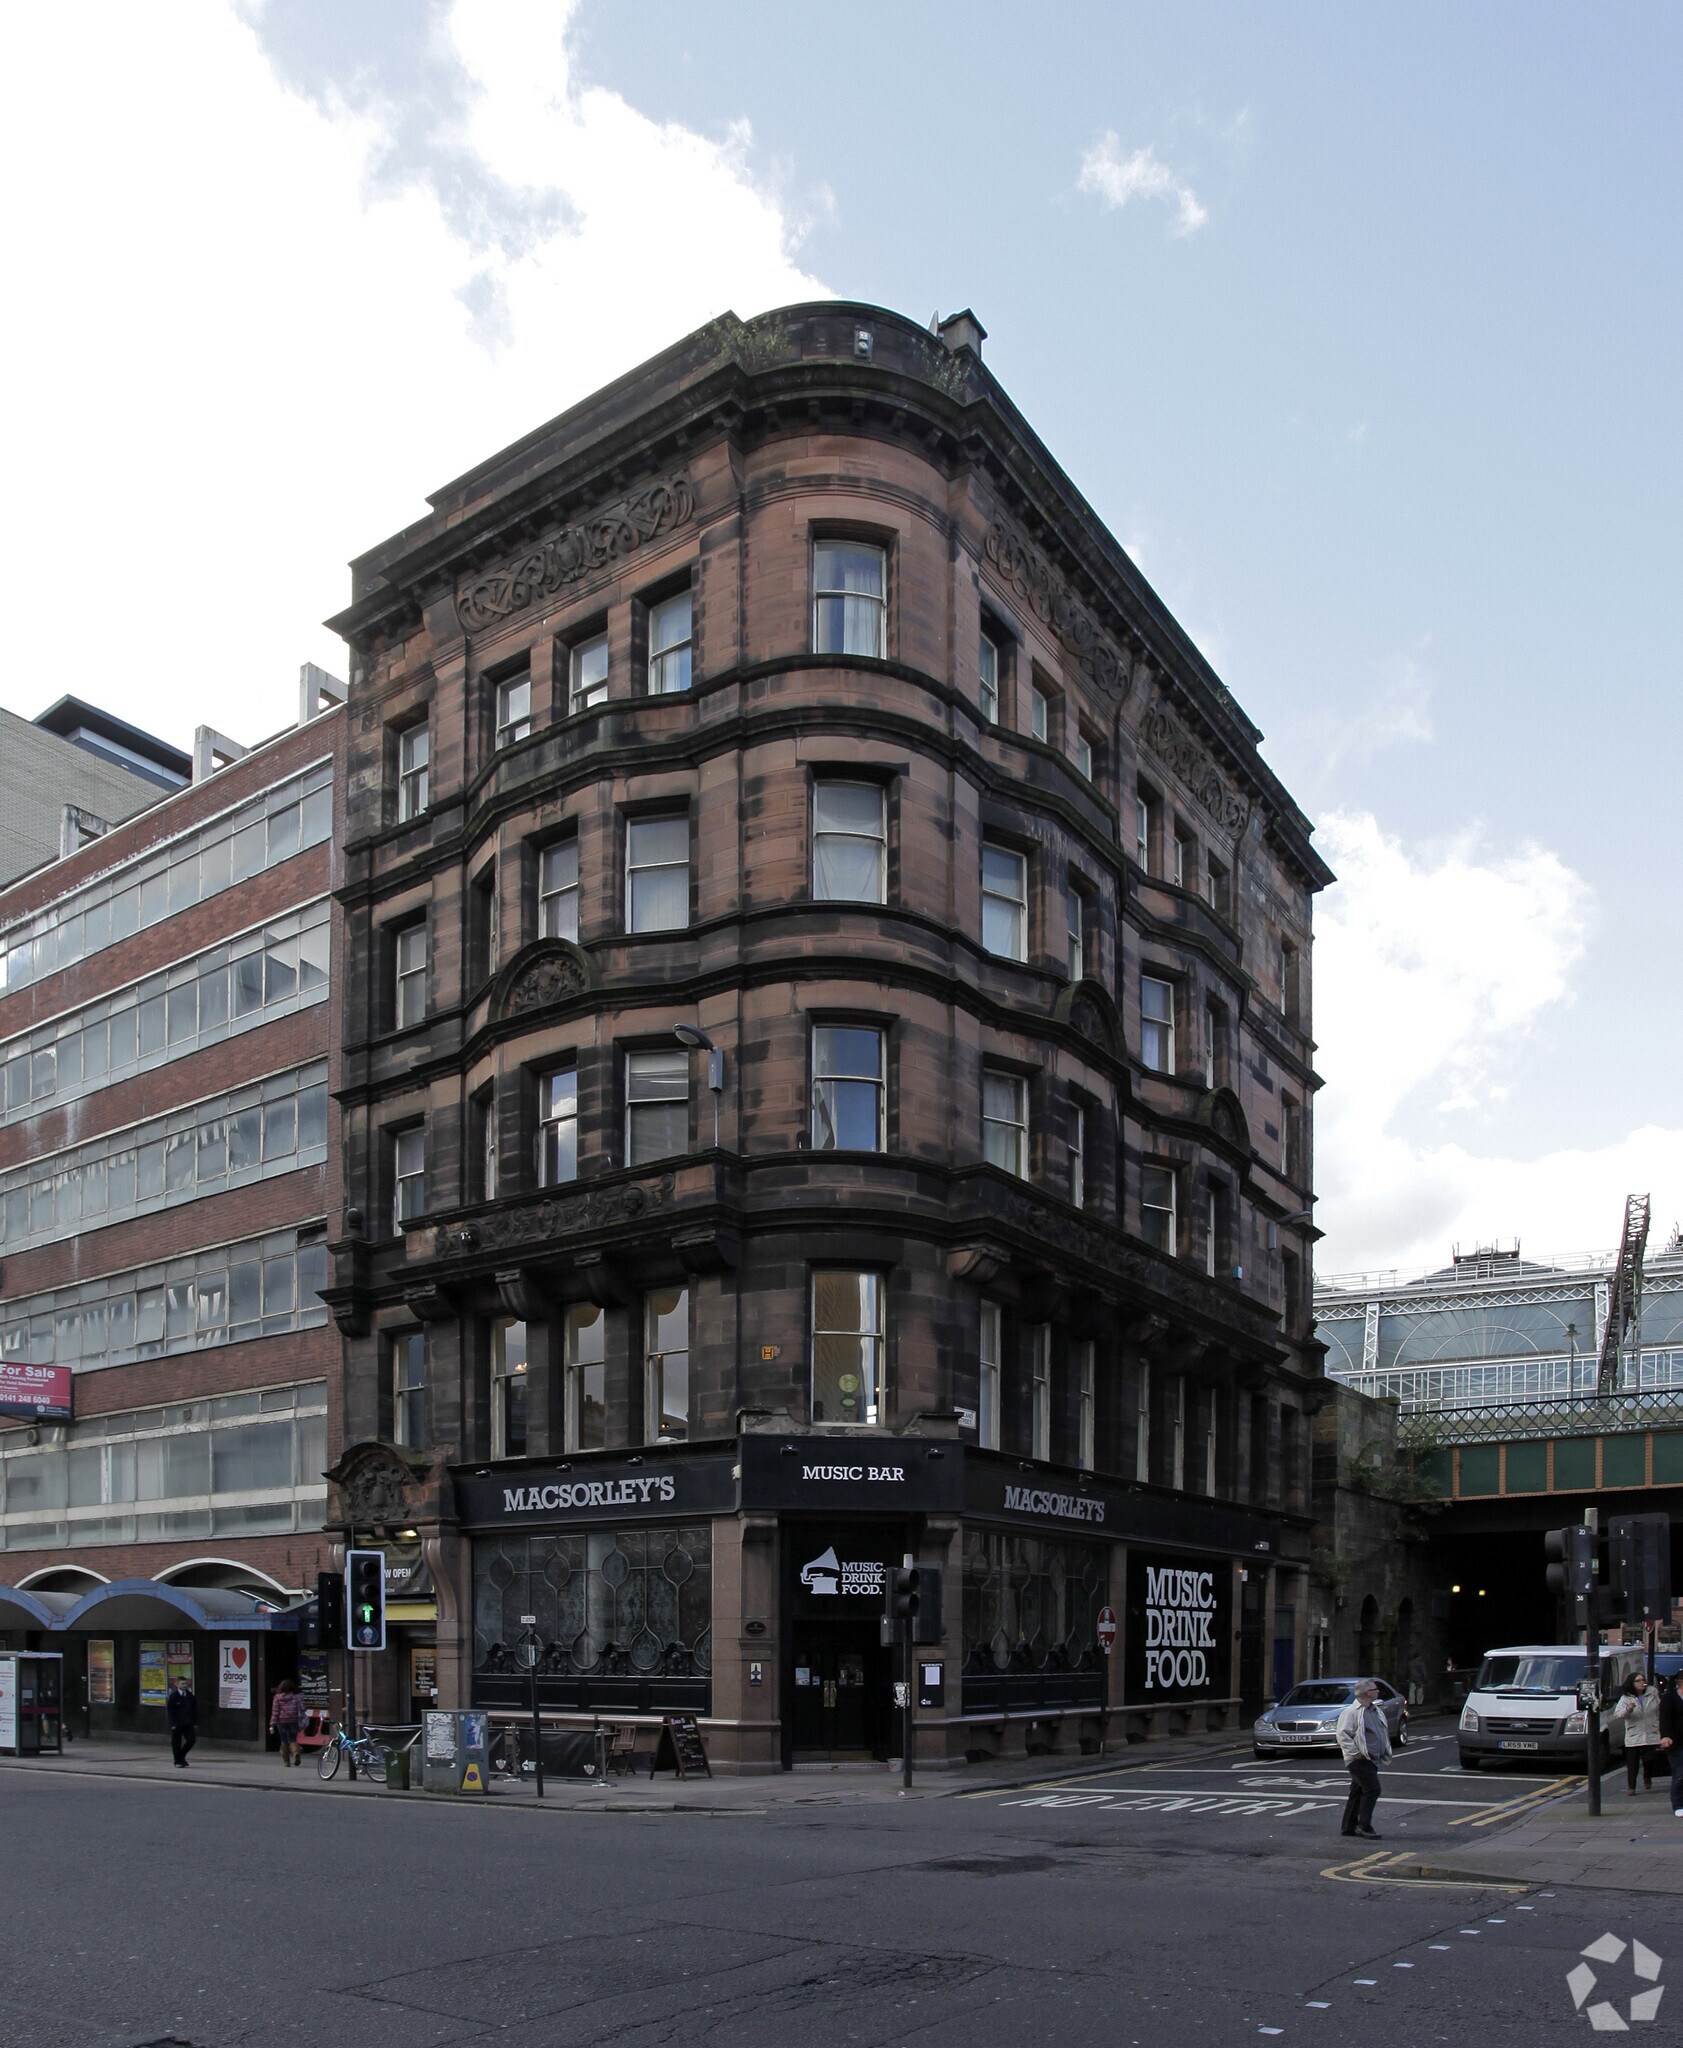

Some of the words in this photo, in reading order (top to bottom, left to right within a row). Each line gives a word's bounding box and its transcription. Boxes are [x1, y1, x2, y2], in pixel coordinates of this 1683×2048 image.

[0, 1364, 21, 1376] For
[25, 1366, 55, 1379] Sale
[0, 1393, 16, 1402] 0141
[18, 1395, 32, 1403] 248
[803, 1466, 863, 1480] MUSIC
[868, 1467, 905, 1481] BAR
[504, 1476, 676, 1512] MACSORLEY'S
[1003, 1485, 1105, 1522] MACSORLEY'S
[392, 1567, 412, 1578] OPEN
[841, 1562, 886, 1573] MUSIC.
[841, 1573, 886, 1583] DRINK.
[841, 1584, 883, 1595] FOOD.
[1146, 1566, 1217, 1609] MUSIC.
[1145, 1608, 1216, 1648] DRINK.
[223, 1647, 231, 1668] I
[1145, 1649, 1210, 1689] FOOD.
[223, 1672, 248, 1683] garage
[999, 1795, 1115, 1808] NO
[1099, 1796, 1340, 1817] ENTRY
